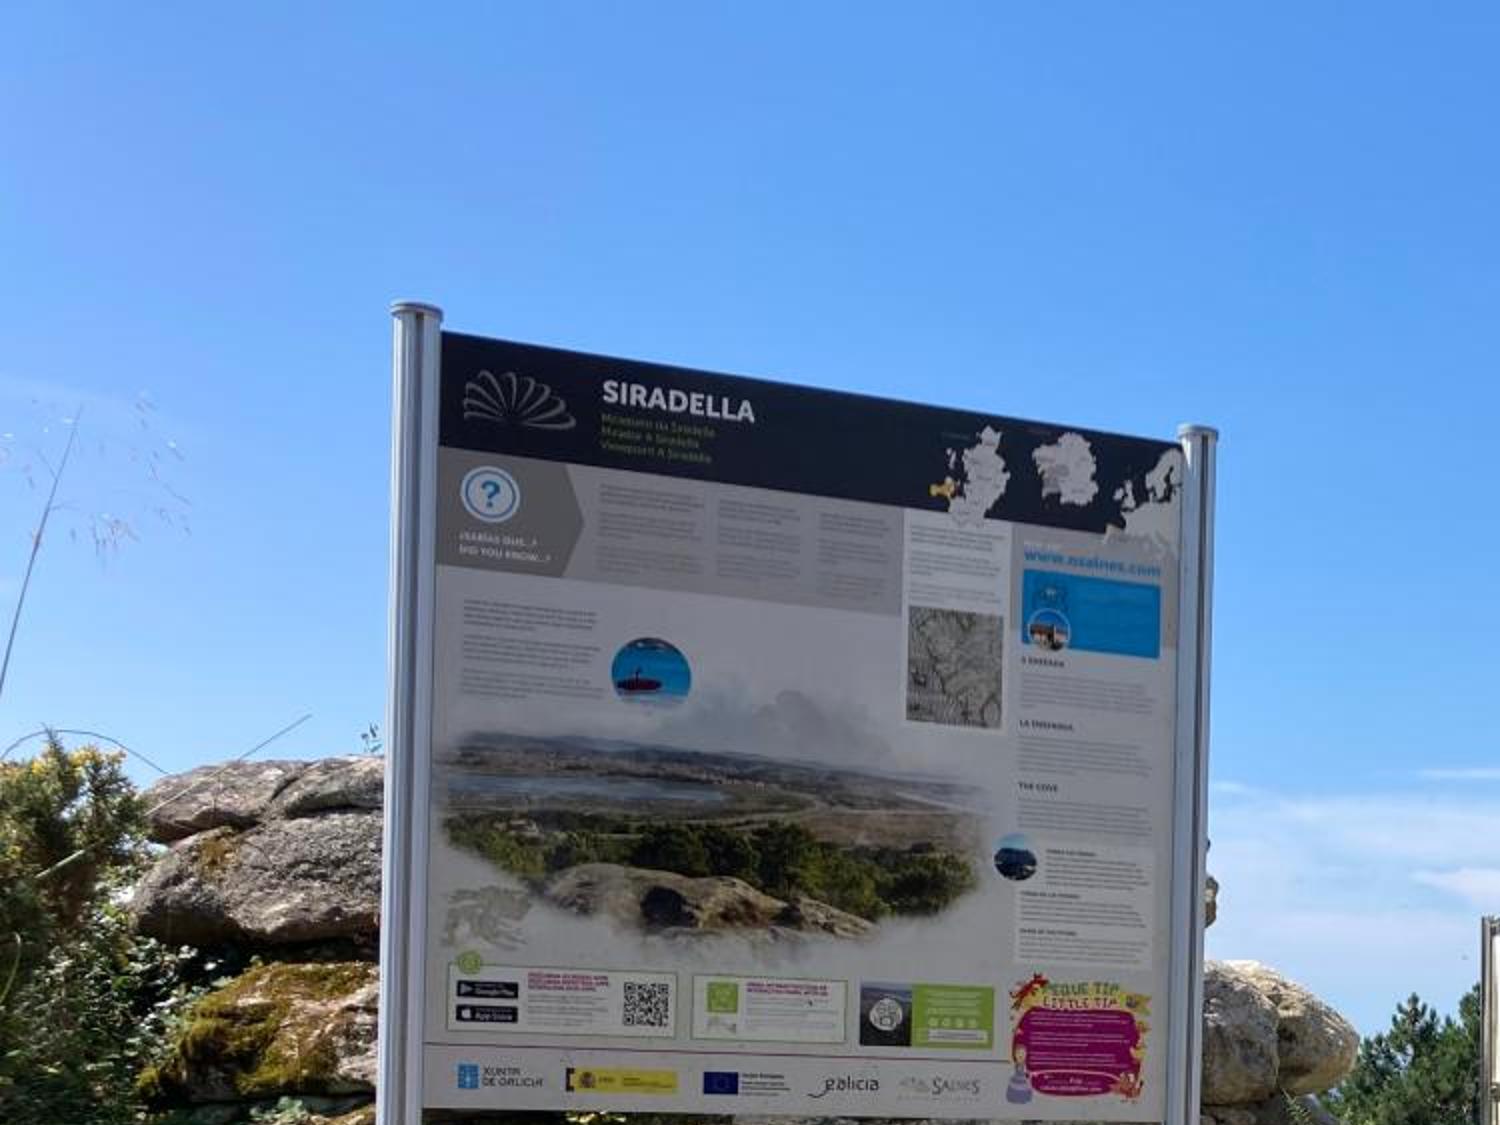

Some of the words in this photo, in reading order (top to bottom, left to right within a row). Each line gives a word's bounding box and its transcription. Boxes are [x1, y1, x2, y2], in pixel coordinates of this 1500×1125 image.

[602, 379, 755, 423] SIRADELLA
[480, 546, 503, 559] YOU
[483, 1066, 521, 1077] XUNTA
[482, 1077, 495, 1087] DE
[498, 1077, 543, 1088] GALICIA
[815, 1074, 880, 1096] galicia
